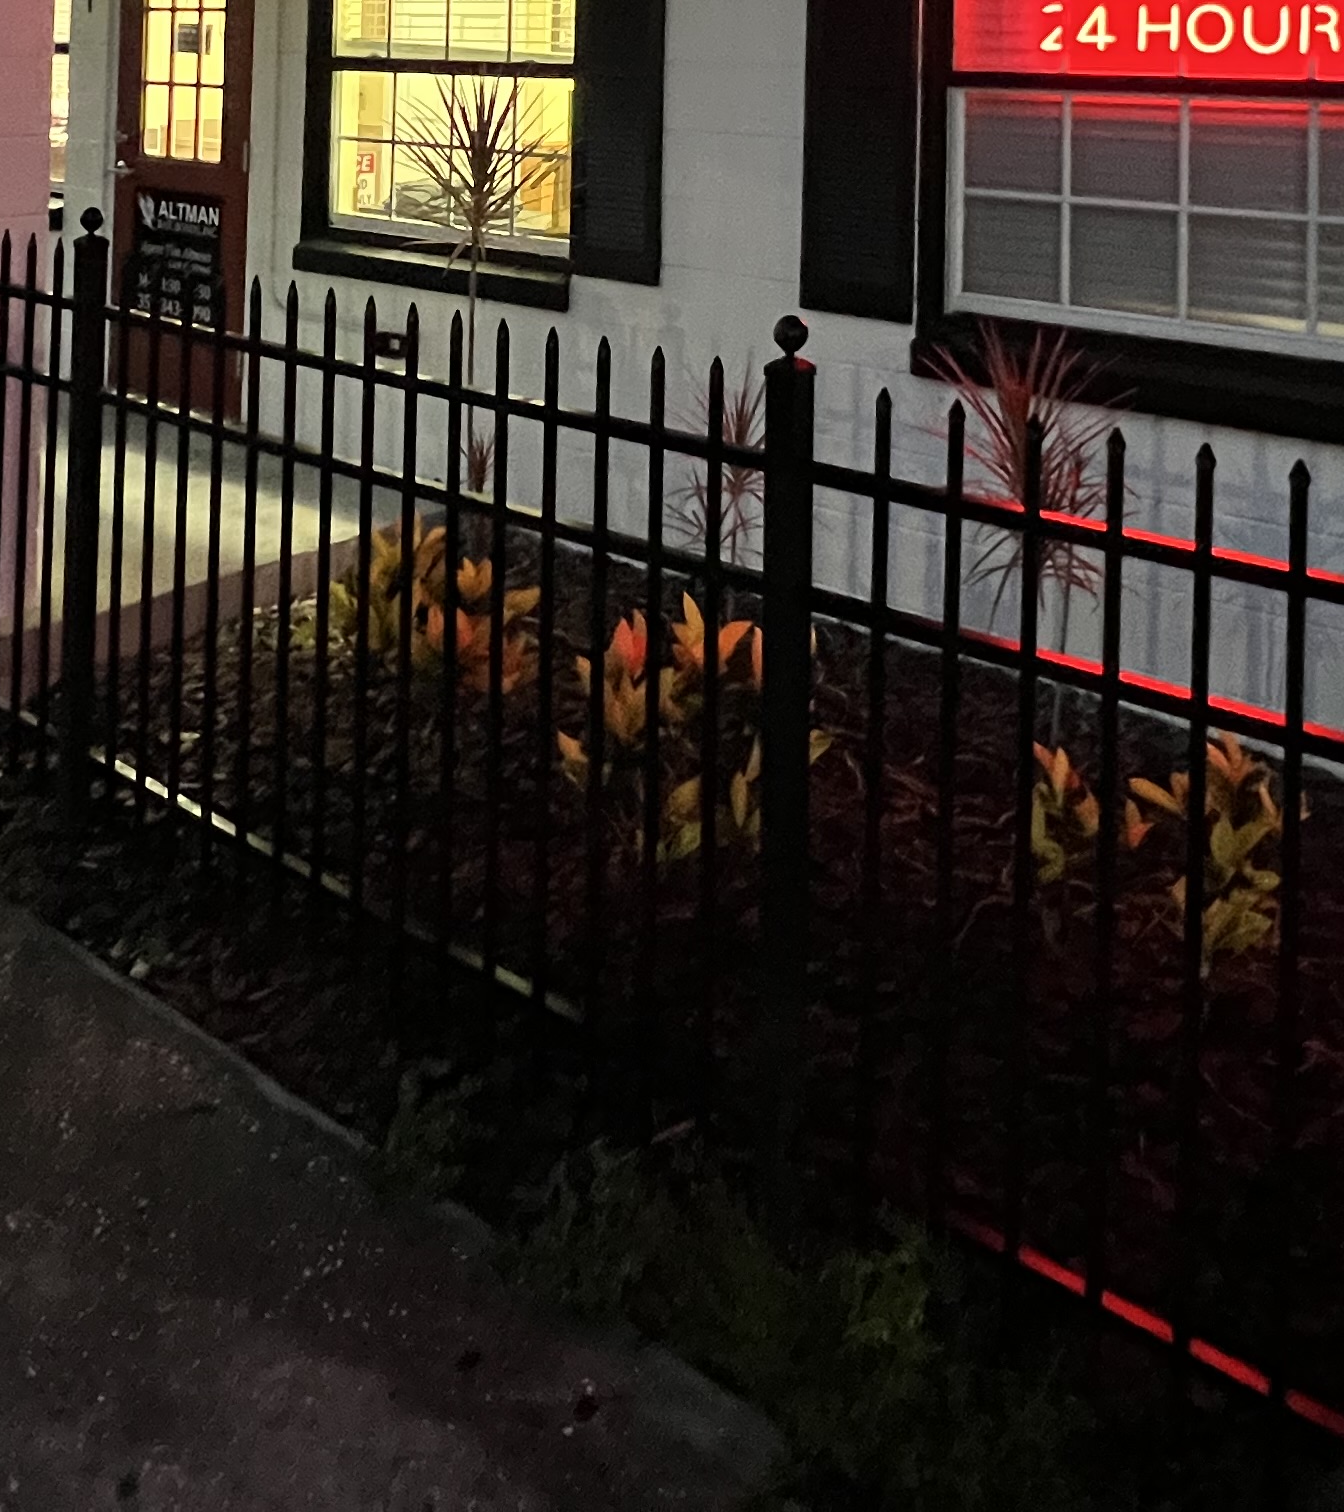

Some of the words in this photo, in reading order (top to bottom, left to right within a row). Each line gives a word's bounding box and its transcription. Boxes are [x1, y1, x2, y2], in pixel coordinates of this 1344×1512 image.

[1039, 2, 1117, 54] 24
[1136, 2, 1342, 56] HOUR
[158, 200, 220, 227] ALTMAN
